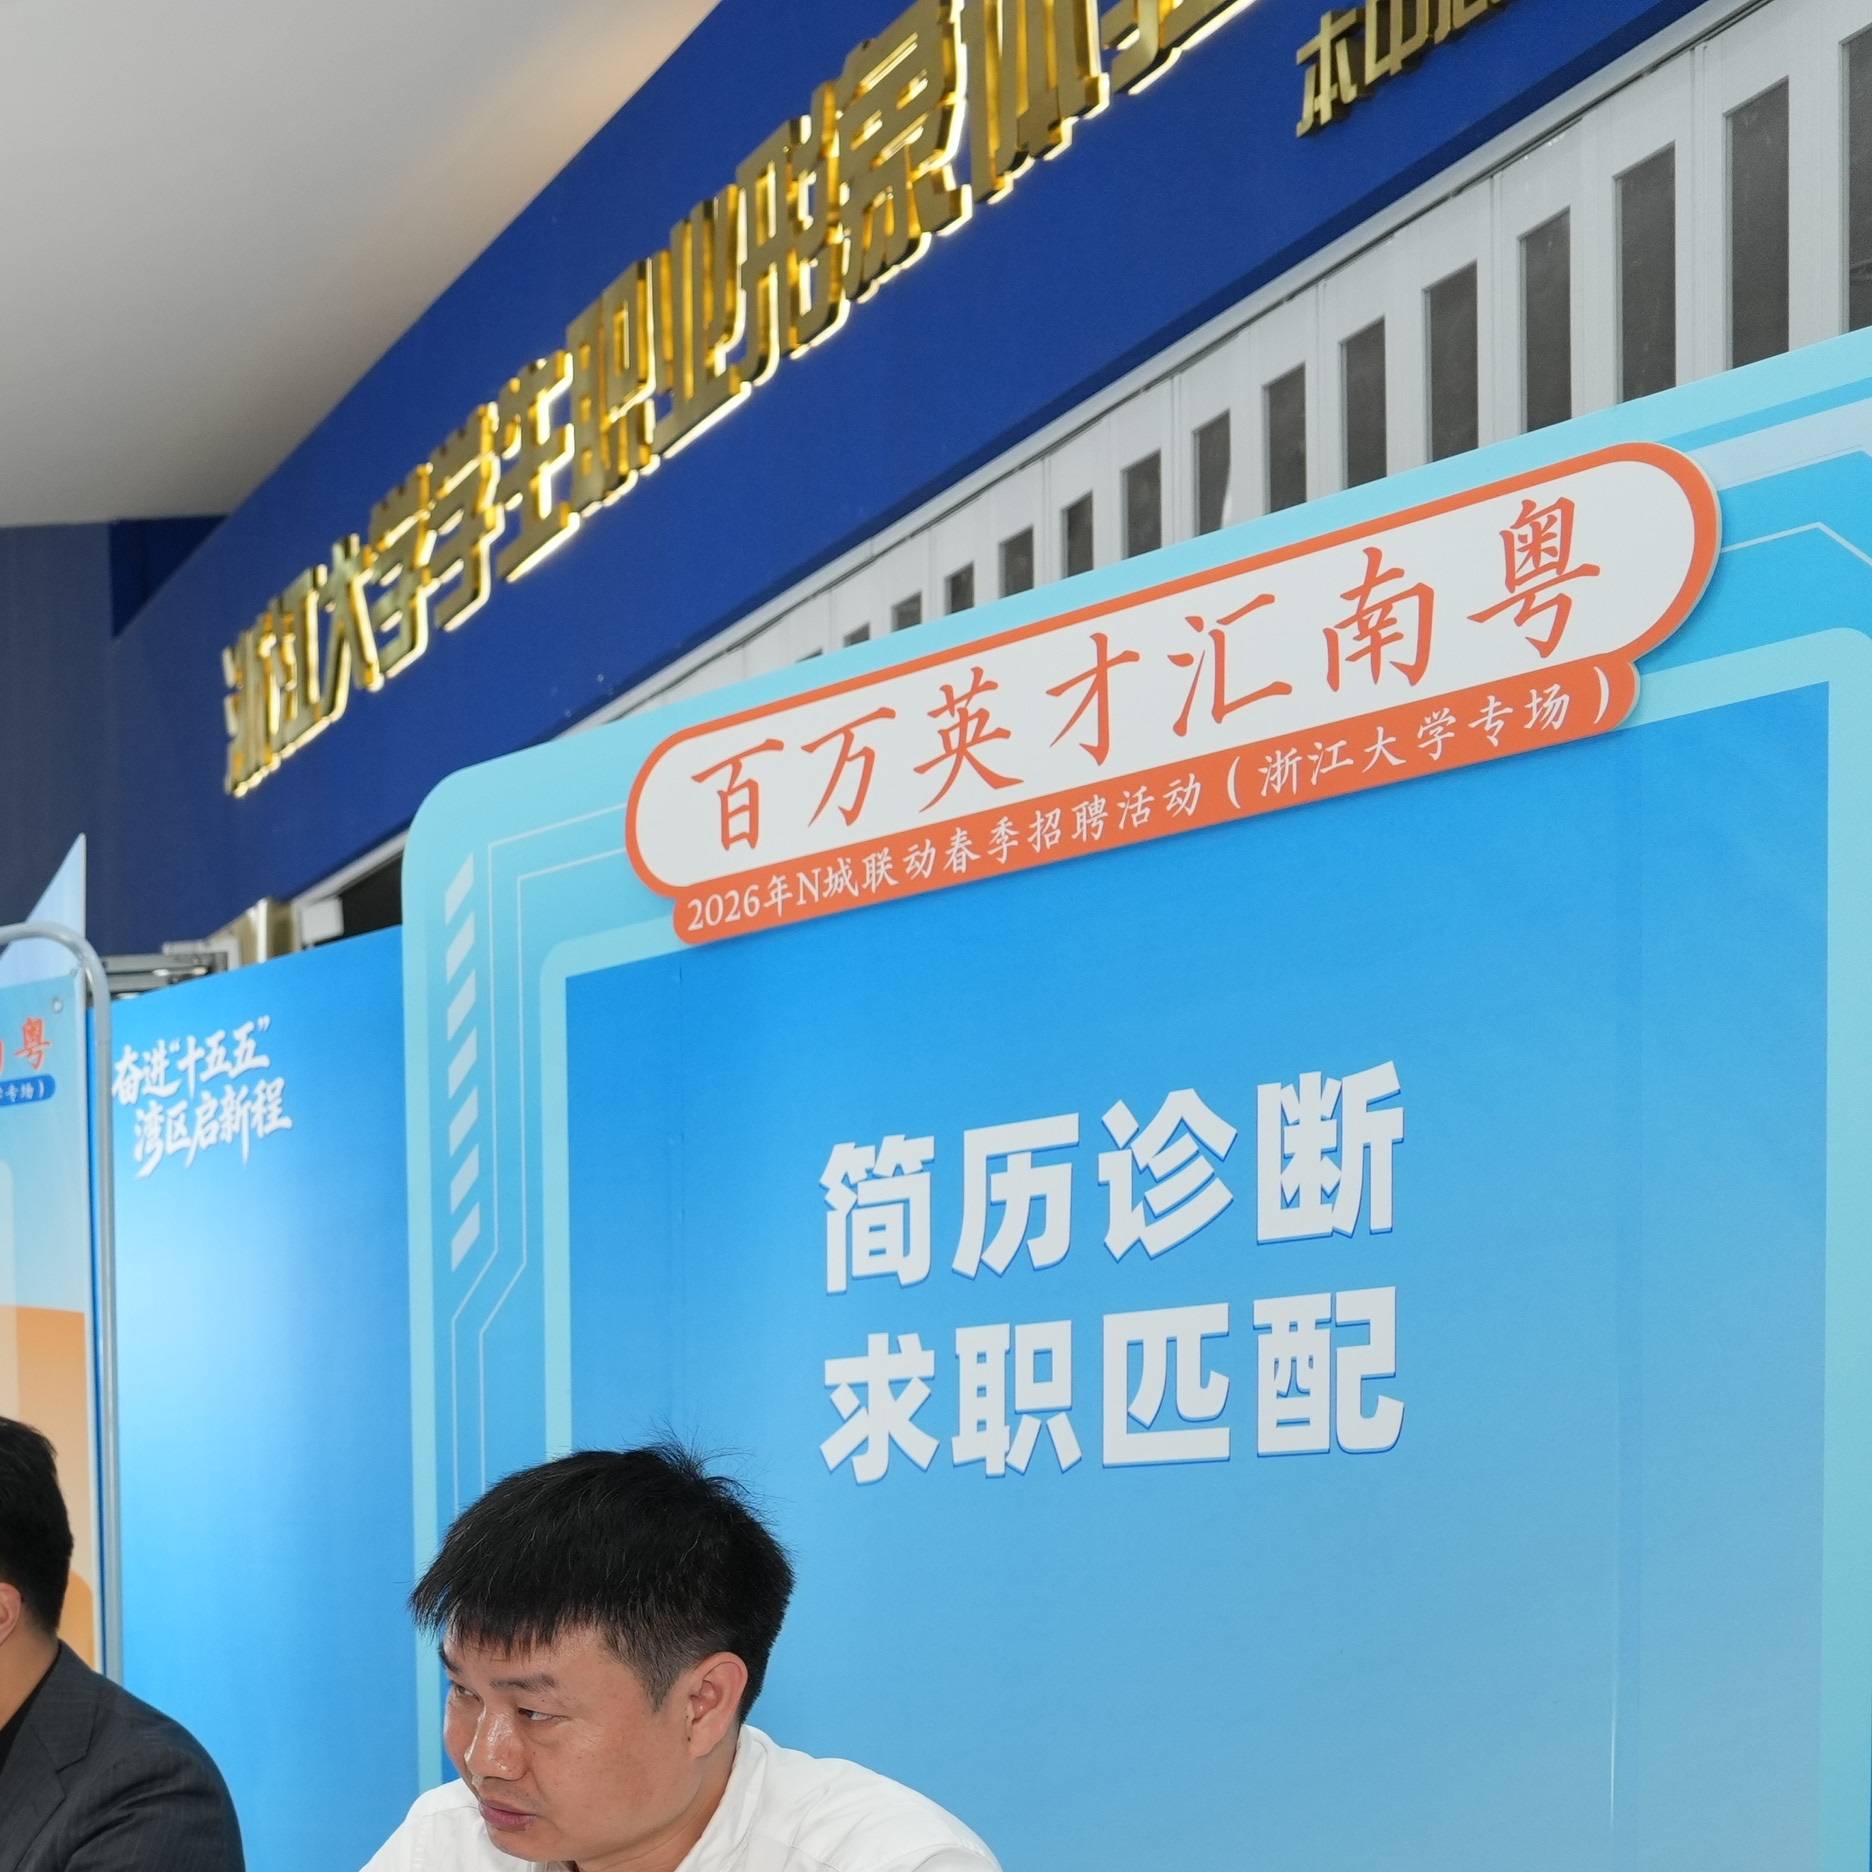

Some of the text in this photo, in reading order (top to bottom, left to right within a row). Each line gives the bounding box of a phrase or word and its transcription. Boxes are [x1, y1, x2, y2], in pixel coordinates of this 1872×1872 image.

[1296, 0, 1506, 138] 本中
[223, 0, 1256, 798] 浙江大学学生职业形象体
[689, 496, 1601, 853] 百万英才汇南粤
[687, 665, 1612, 933] 2026年N城联动春季招聘活动（浙江大学专场）
[133, 1076, 294, 1181] 湾区启新程
[818, 1060, 1405, 1295] 简历诊断
[819, 1286, 1405, 1486] 求职匹配
